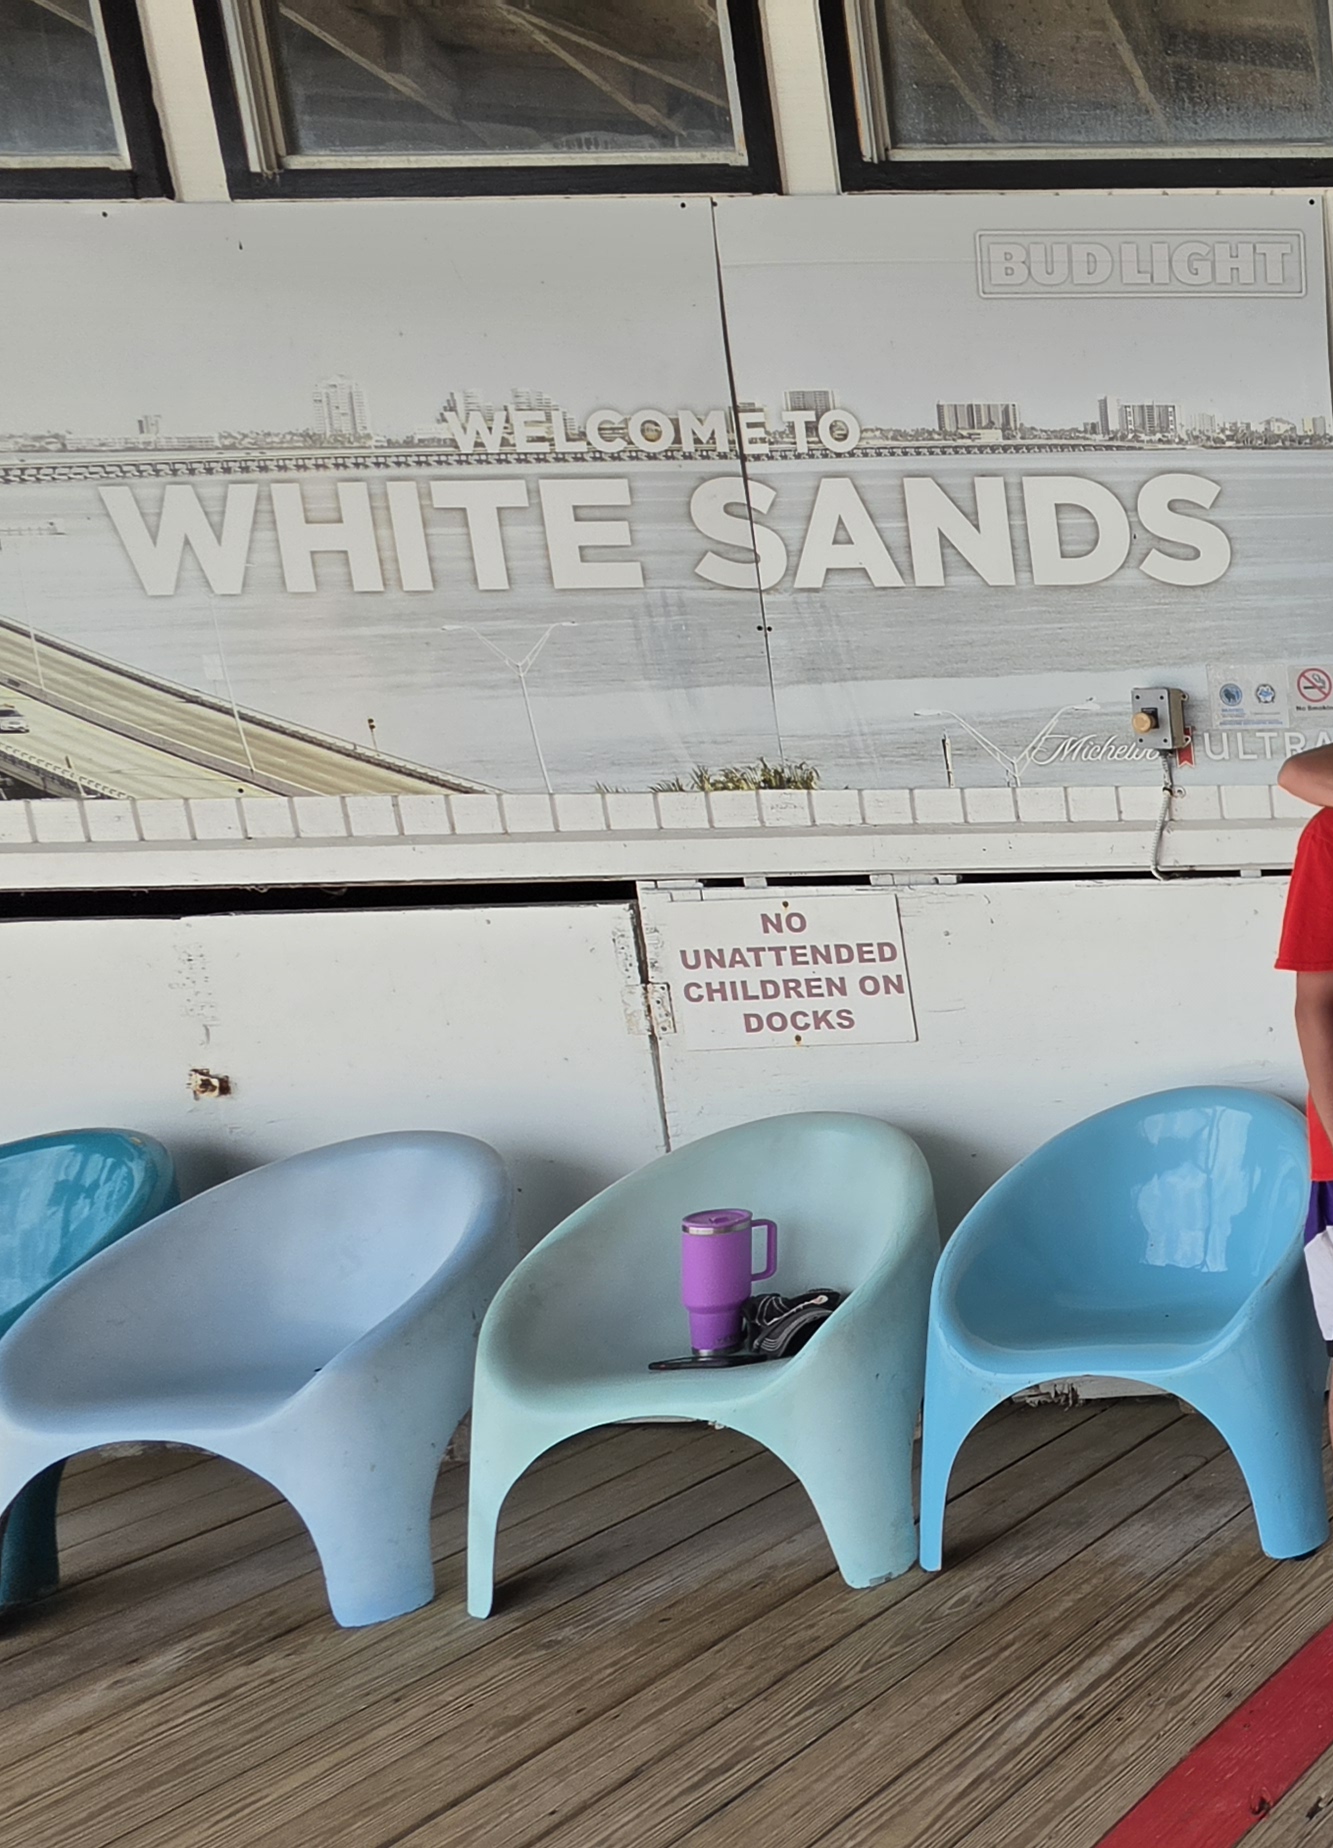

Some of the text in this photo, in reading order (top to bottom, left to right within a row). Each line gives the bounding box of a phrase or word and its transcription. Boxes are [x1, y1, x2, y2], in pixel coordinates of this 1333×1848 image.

[988, 240, 1293, 286] BUD LIGHT
[441, 408, 861, 454] WELCOME TO
[98, 472, 1233, 596] WHITE SANDS
[760, 912, 807, 934] NO
[680, 941, 898, 970] UNATTENDED
[683, 974, 905, 1003] CHILDREN ON
[743, 1008, 855, 1033] DOCKS
